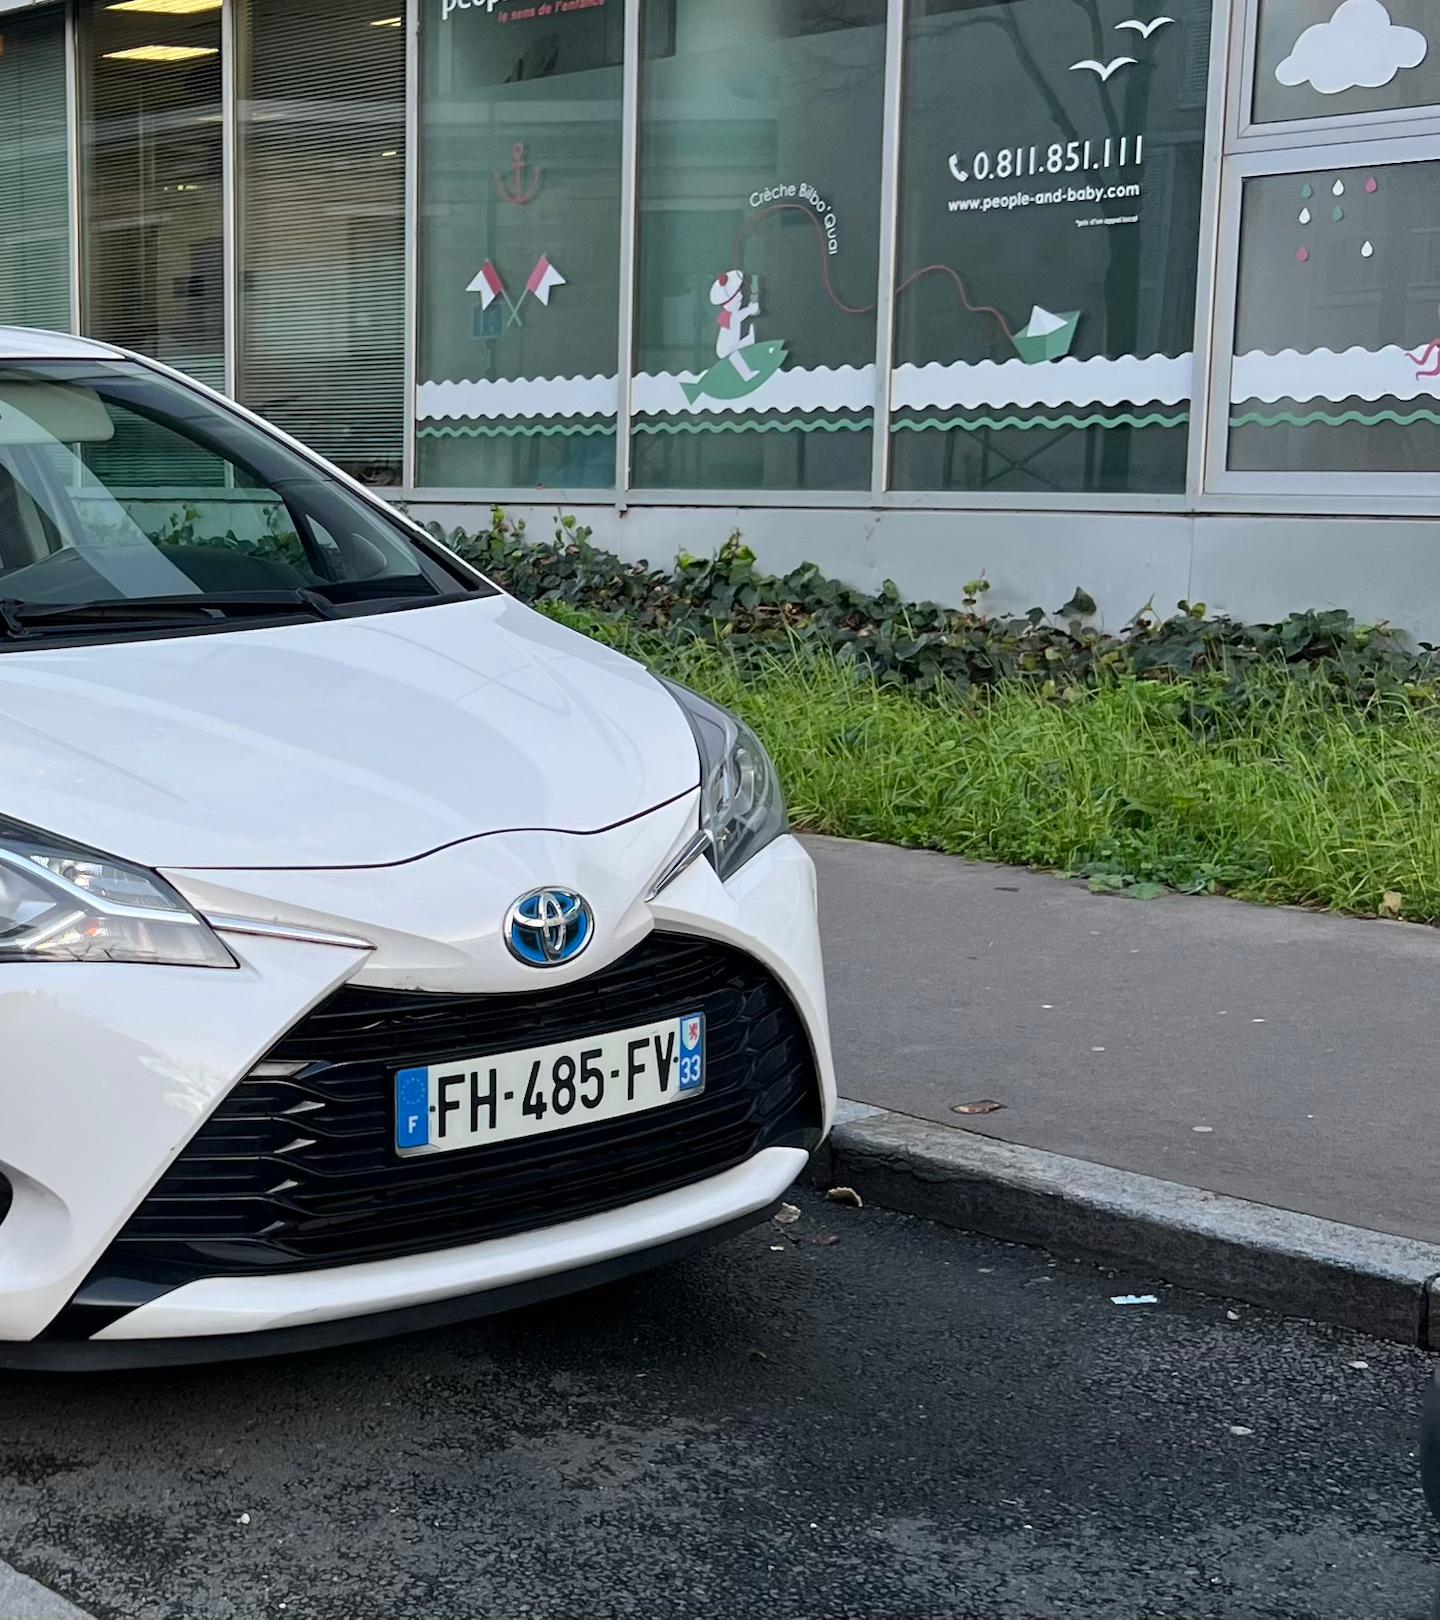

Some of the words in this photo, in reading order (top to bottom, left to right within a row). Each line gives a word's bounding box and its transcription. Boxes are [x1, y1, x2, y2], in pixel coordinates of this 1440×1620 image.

[973, 135, 1143, 180] 0.811.851.111
[749, 184, 797, 207] Crèche
[948, 184, 1140, 212] www.people-and-baby.com
[407, 1115, 419, 1134] F
[438, 1032, 676, 1138] FH-485-FV
[680, 1055, 702, 1083] 33
